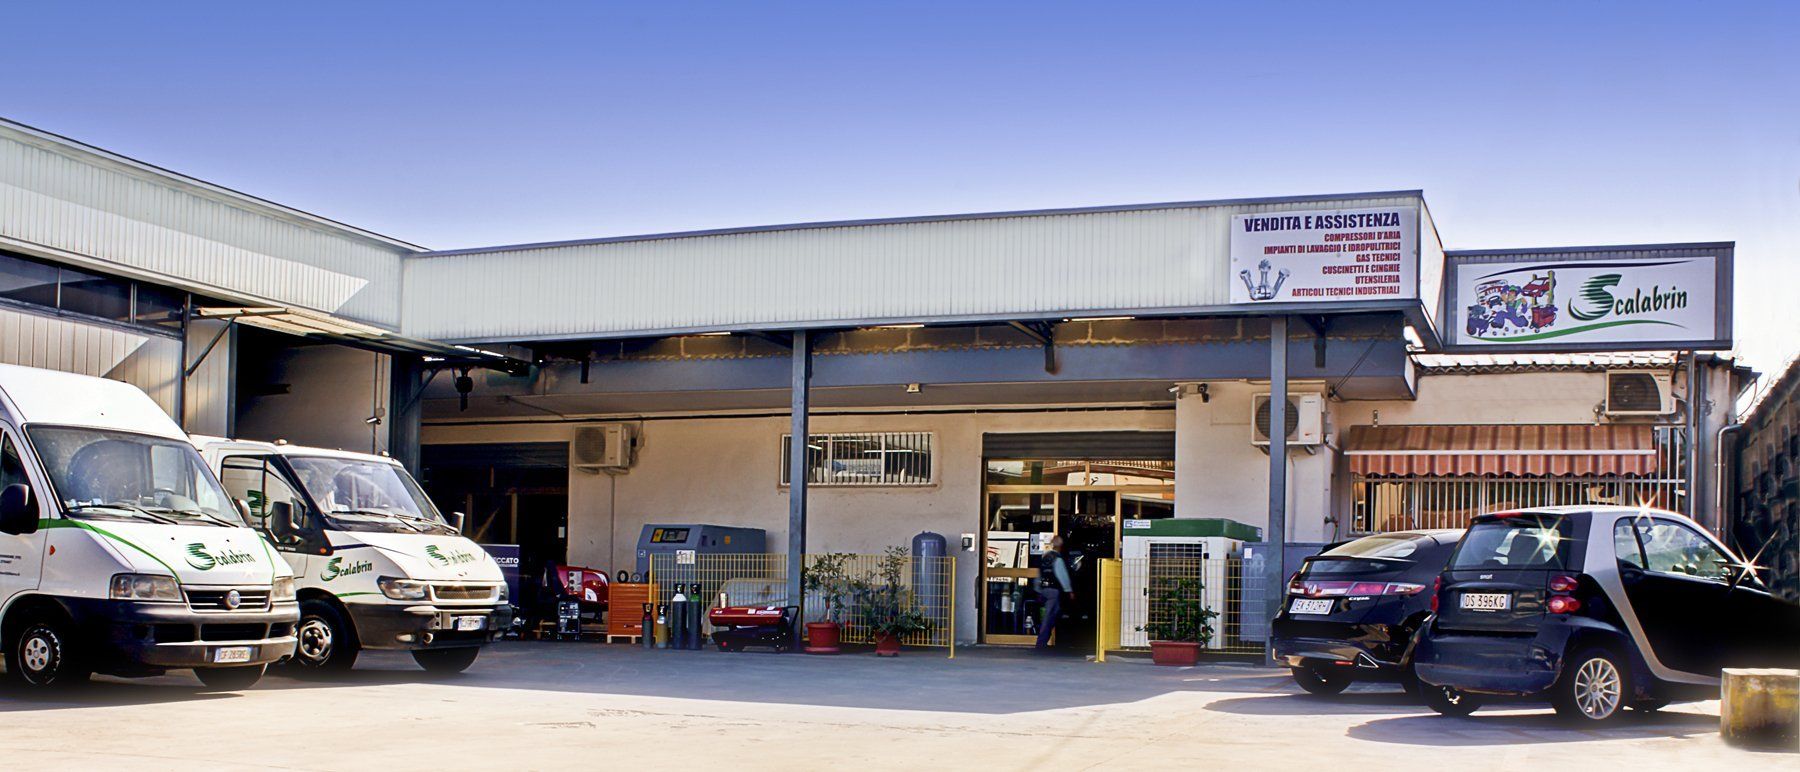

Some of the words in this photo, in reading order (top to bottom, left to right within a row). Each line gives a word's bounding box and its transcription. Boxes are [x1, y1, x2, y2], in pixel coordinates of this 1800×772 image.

[1245, 216, 1301, 232] VENDITA
[1305, 215, 1312, 230] E
[1315, 212, 1400, 229] ASSISTENZA
[1324, 232, 1375, 242] COMPRESSORI
[1377, 231, 1401, 240] D'ARIA
[1264, 245, 1296, 255] IMPIANTI
[1298, 245, 1305, 254] DI
[1306, 244, 1341, 253] LAVAGGIO
[1343, 243, 1347, 252] E
[1348, 242, 1400, 252] IDROPULITRICI
[1356, 254, 1371, 262] GAS
[1372, 253, 1400, 262] TECNICI
[1322, 265, 1364, 275] CUSCINETTI
[1365, 264, 1369, 273] E
[1371, 264, 1400, 273] CINGHIE
[1355, 275, 1400, 284] UTENSILERIA
[1292, 287, 1324, 297] ARTICOLI
[1325, 287, 1354, 296] TECNICI
[1355, 285, 1400, 295] INDUSTRIALI
[1568, 273, 1688, 321] Scalabrin
[184, 542, 256, 571] Scalabrin
[320, 556, 373, 582] Scalabrin
[1464, 595, 1475, 607] DS
[1477, 595, 1504, 608] 396KG
